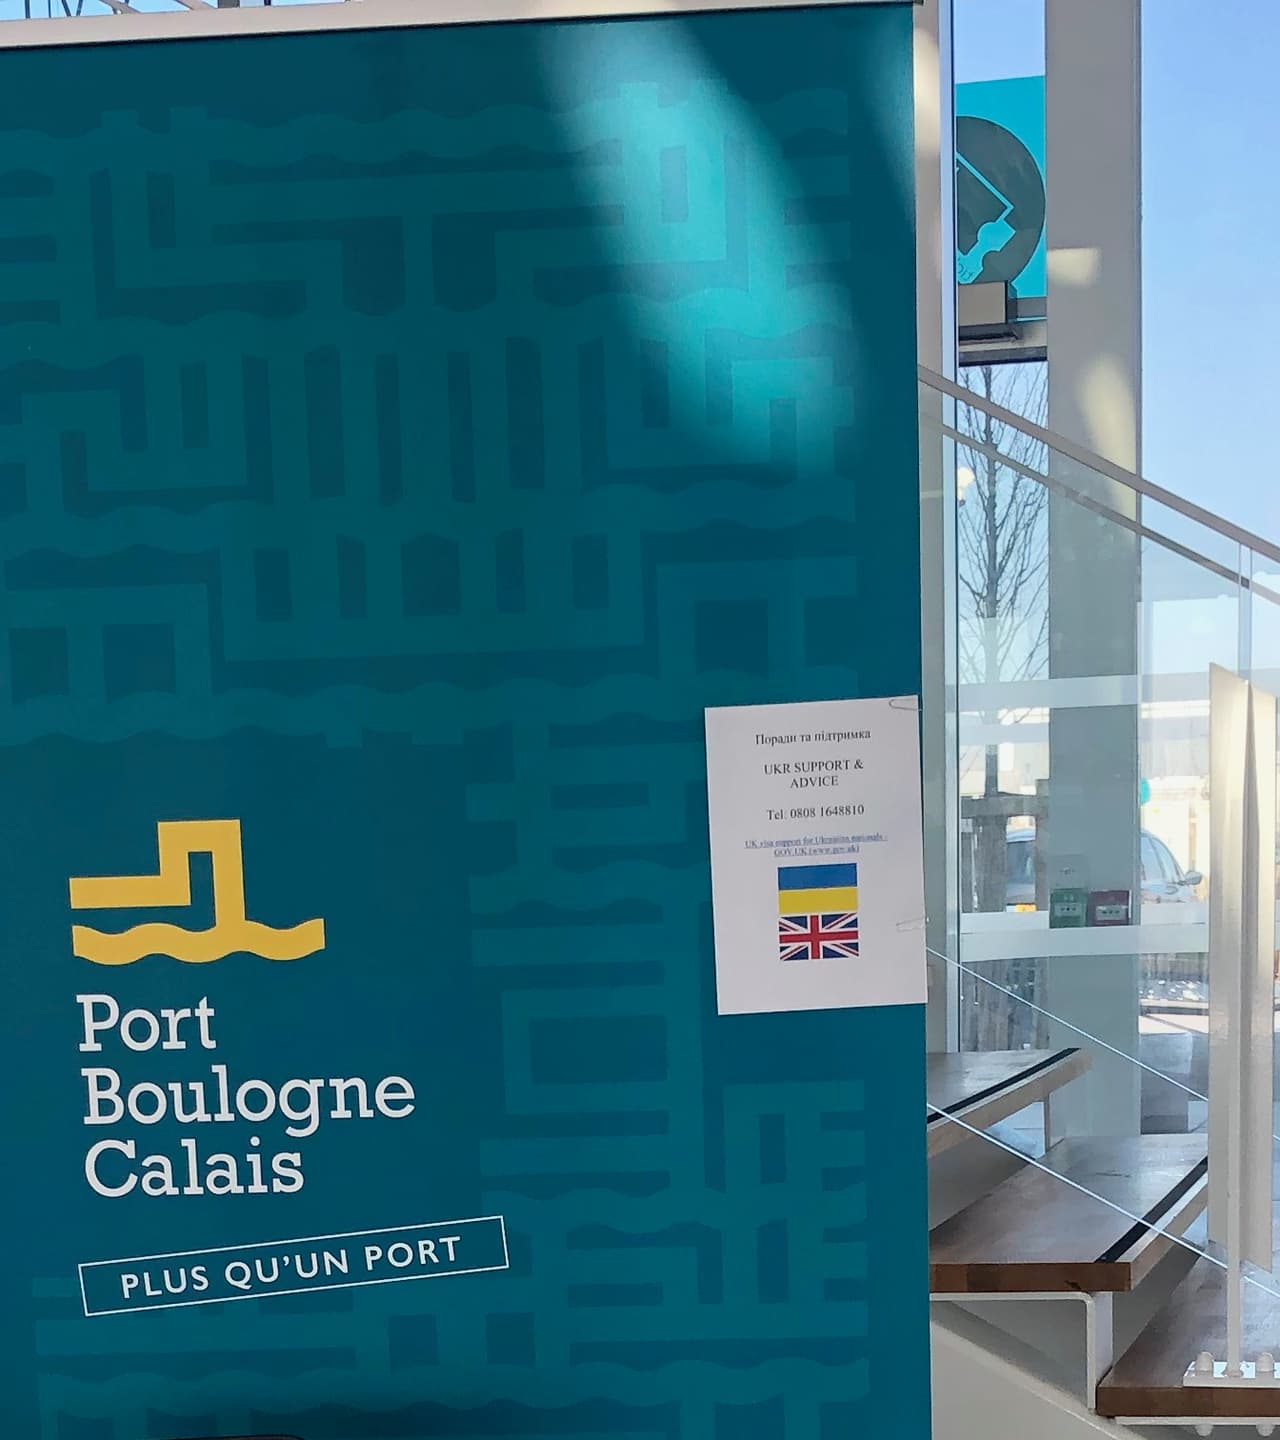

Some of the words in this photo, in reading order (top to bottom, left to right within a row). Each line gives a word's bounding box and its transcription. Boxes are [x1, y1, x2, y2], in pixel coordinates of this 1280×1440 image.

[764, 763, 791, 775] UKR
[794, 759, 851, 774] SUPPORT
[853, 758, 864, 770] &
[790, 775, 839, 789] ADVICE
[789, 807, 816, 820] 0808
[819, 804, 865, 818] 1648810
[75, 993, 217, 1053] Port
[80, 1064, 416, 1138] Boulogne
[84, 1136, 305, 1198] Calais
[120, 1265, 210, 1299] PLUS
[224, 1249, 350, 1290] QU'UN
[365, 1235, 462, 1271] PORT
